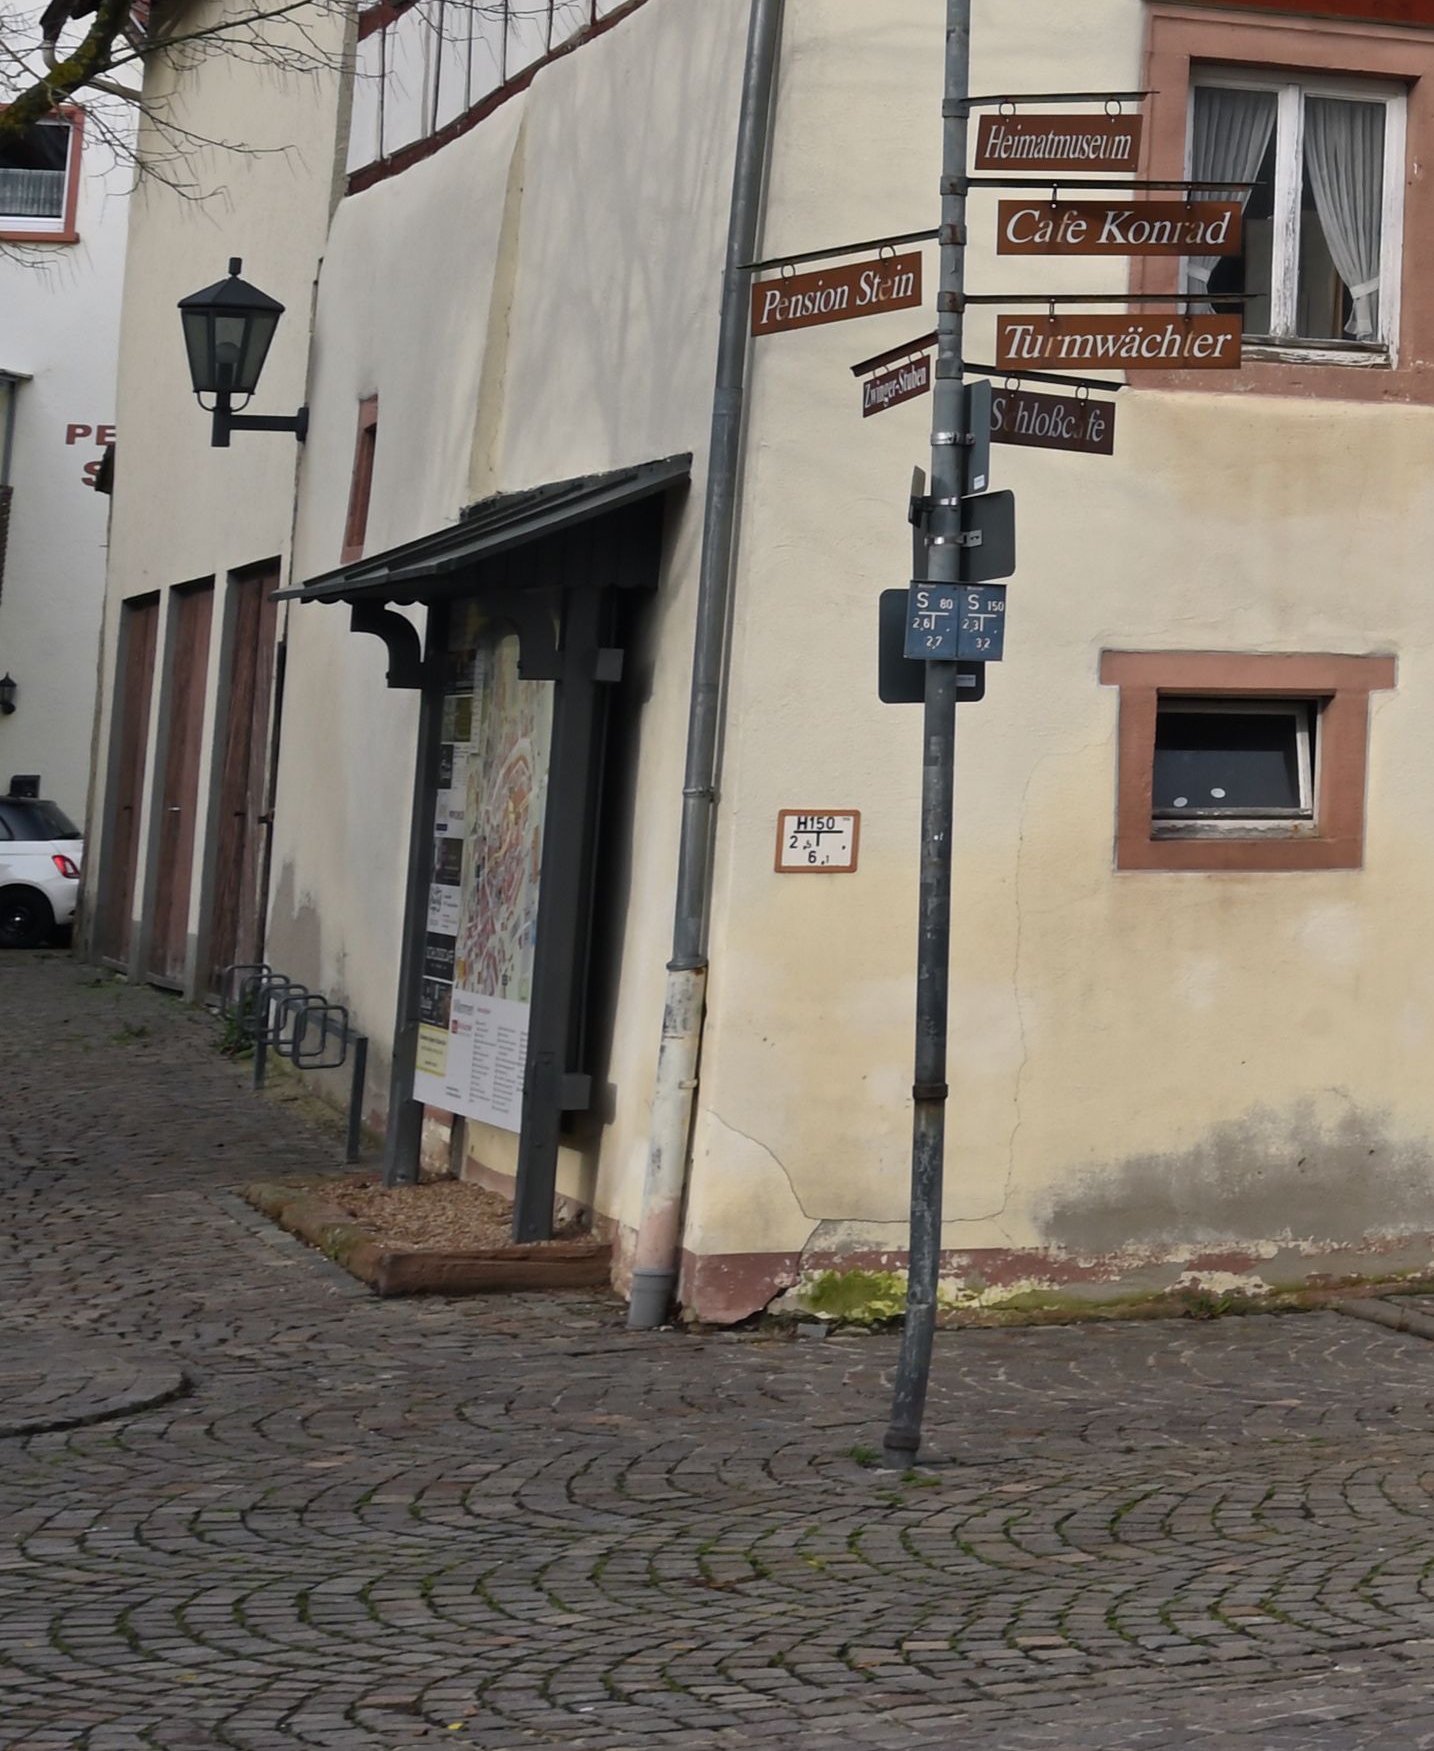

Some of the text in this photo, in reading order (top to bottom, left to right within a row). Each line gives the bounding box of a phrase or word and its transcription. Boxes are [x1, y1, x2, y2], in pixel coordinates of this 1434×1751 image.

[984, 123, 1132, 160] Heimatmuseum
[1006, 208, 1232, 245] Cafe Konrad
[760, 264, 914, 325] Pension Stein
[1004, 323, 1232, 359] Turmwächter
[864, 365, 927, 409] Zwinger-Stuben
[990, 397, 1106, 443] Shloßcfe
[916, 591, 929, 608] S
[967, 594, 1005, 612] S 150
[797, 816, 836, 830] H150
